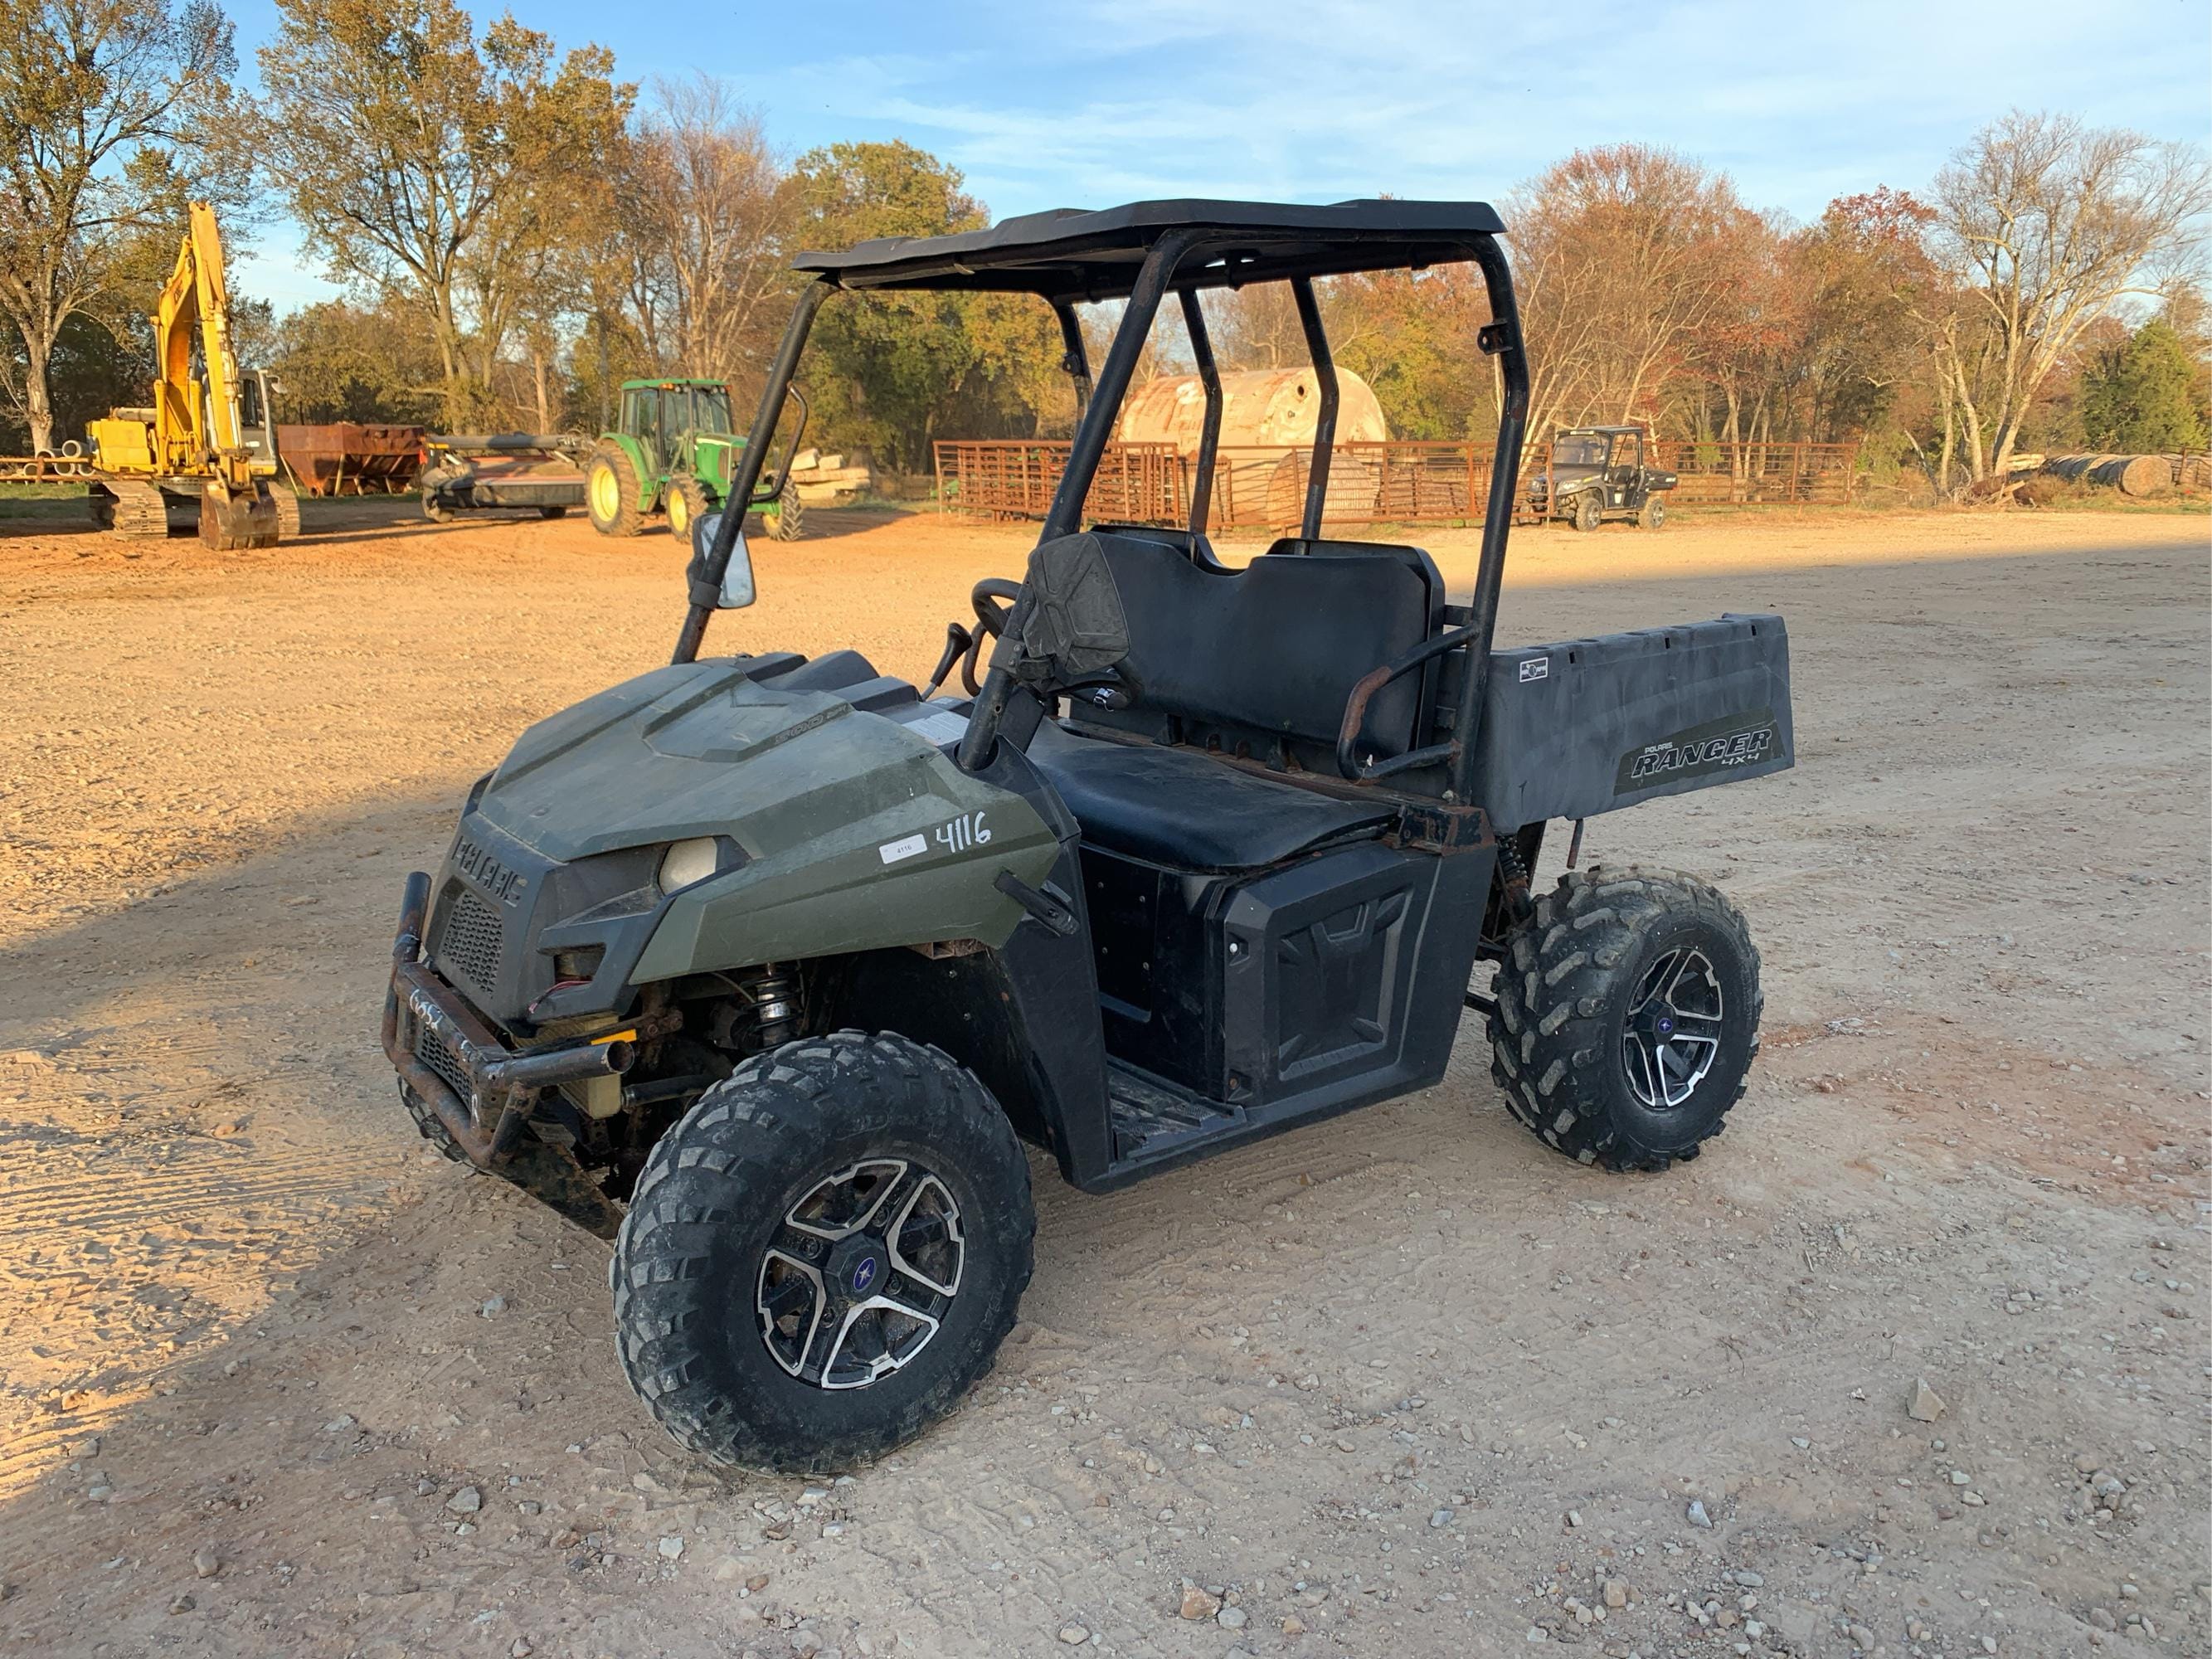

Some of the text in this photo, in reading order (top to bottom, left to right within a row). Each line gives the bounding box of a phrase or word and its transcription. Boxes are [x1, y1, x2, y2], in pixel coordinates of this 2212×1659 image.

[1631, 728, 1772, 779] RANGER
[1645, 742, 1673, 754] POLARIS
[936, 810, 992, 854] 4116
[451, 835, 525, 908] POLARIS
